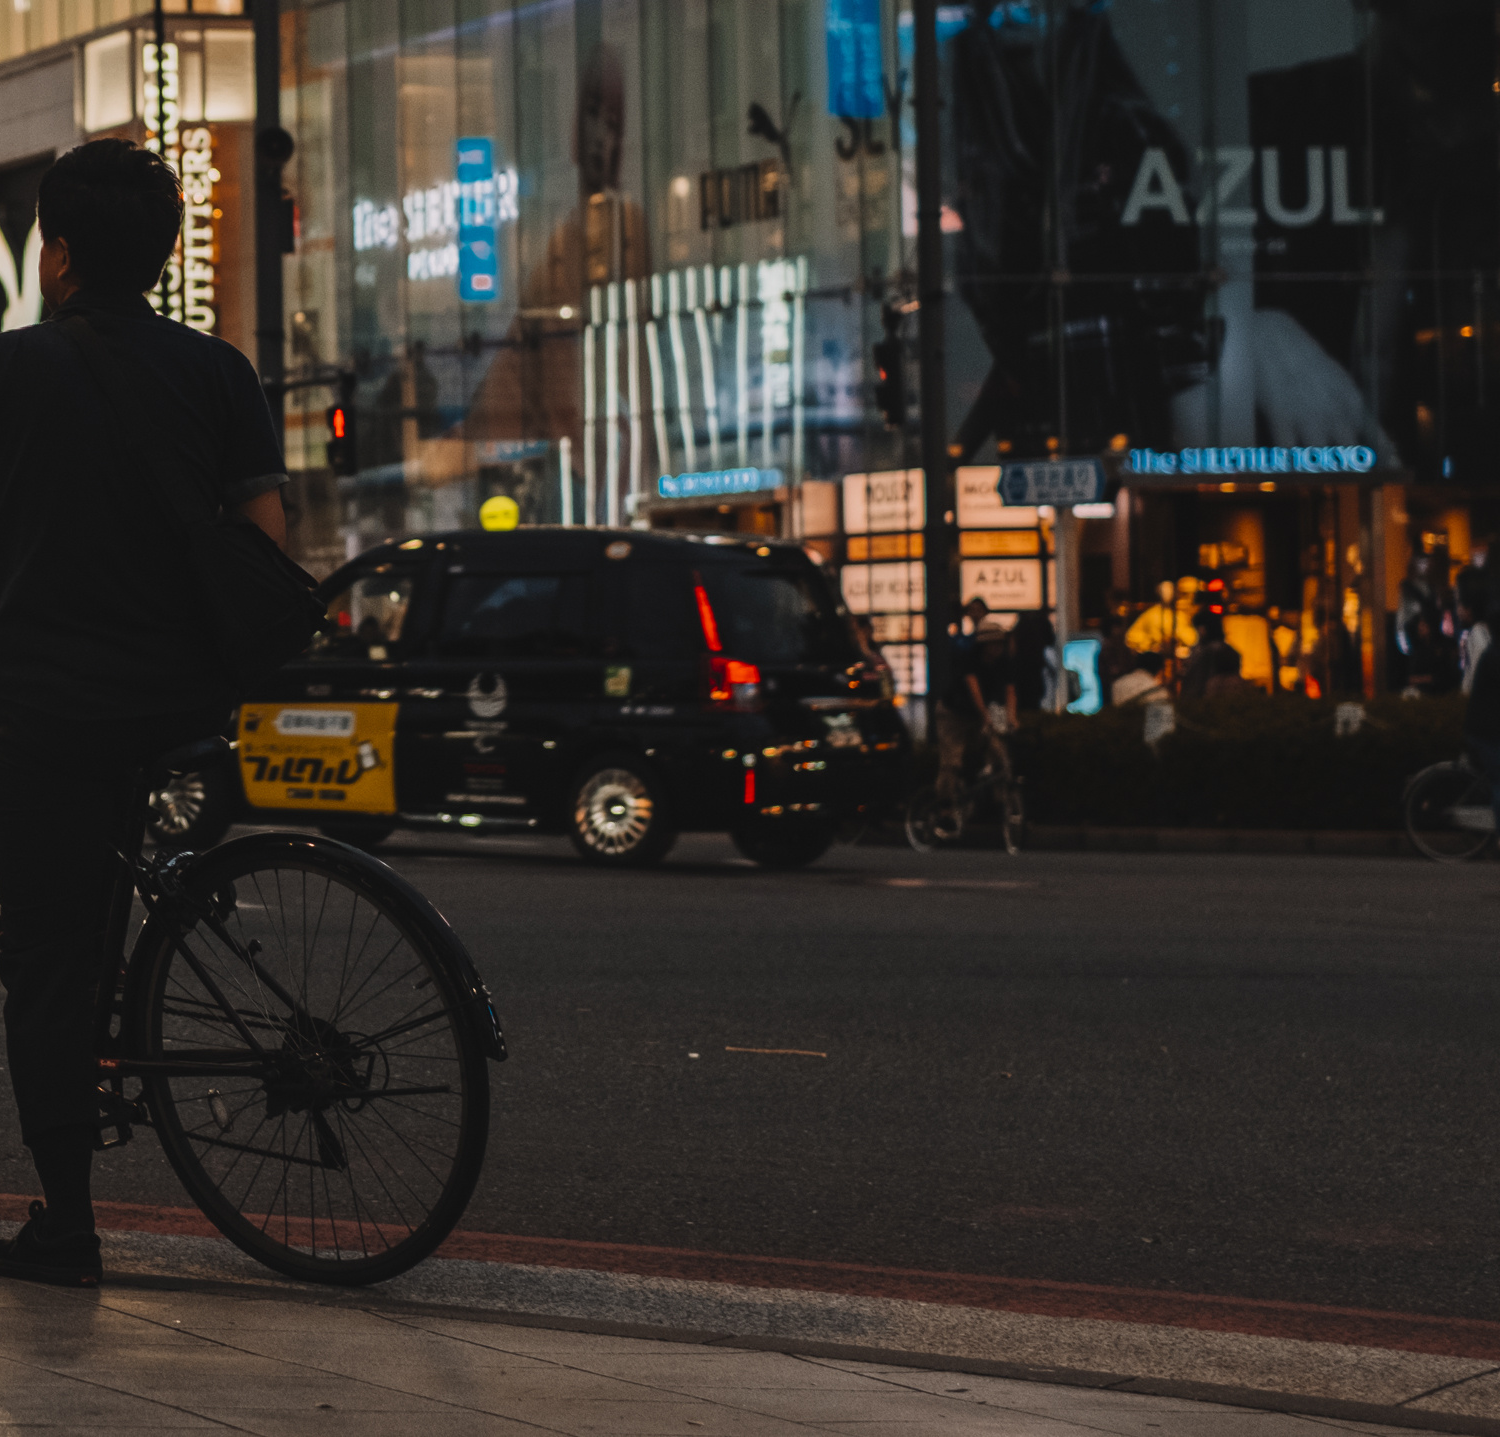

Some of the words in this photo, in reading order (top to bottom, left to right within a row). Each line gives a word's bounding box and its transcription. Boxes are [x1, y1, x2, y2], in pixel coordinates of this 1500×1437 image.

[1121, 147, 1384, 227] AZUL
[182, 127, 215, 333] UTFITTERS
[1127, 448, 1178, 475] The
[1292, 444, 1377, 474] TOKYO
[975, 566, 1028, 587] AZUL
[245, 756, 366, 784] フルクル
